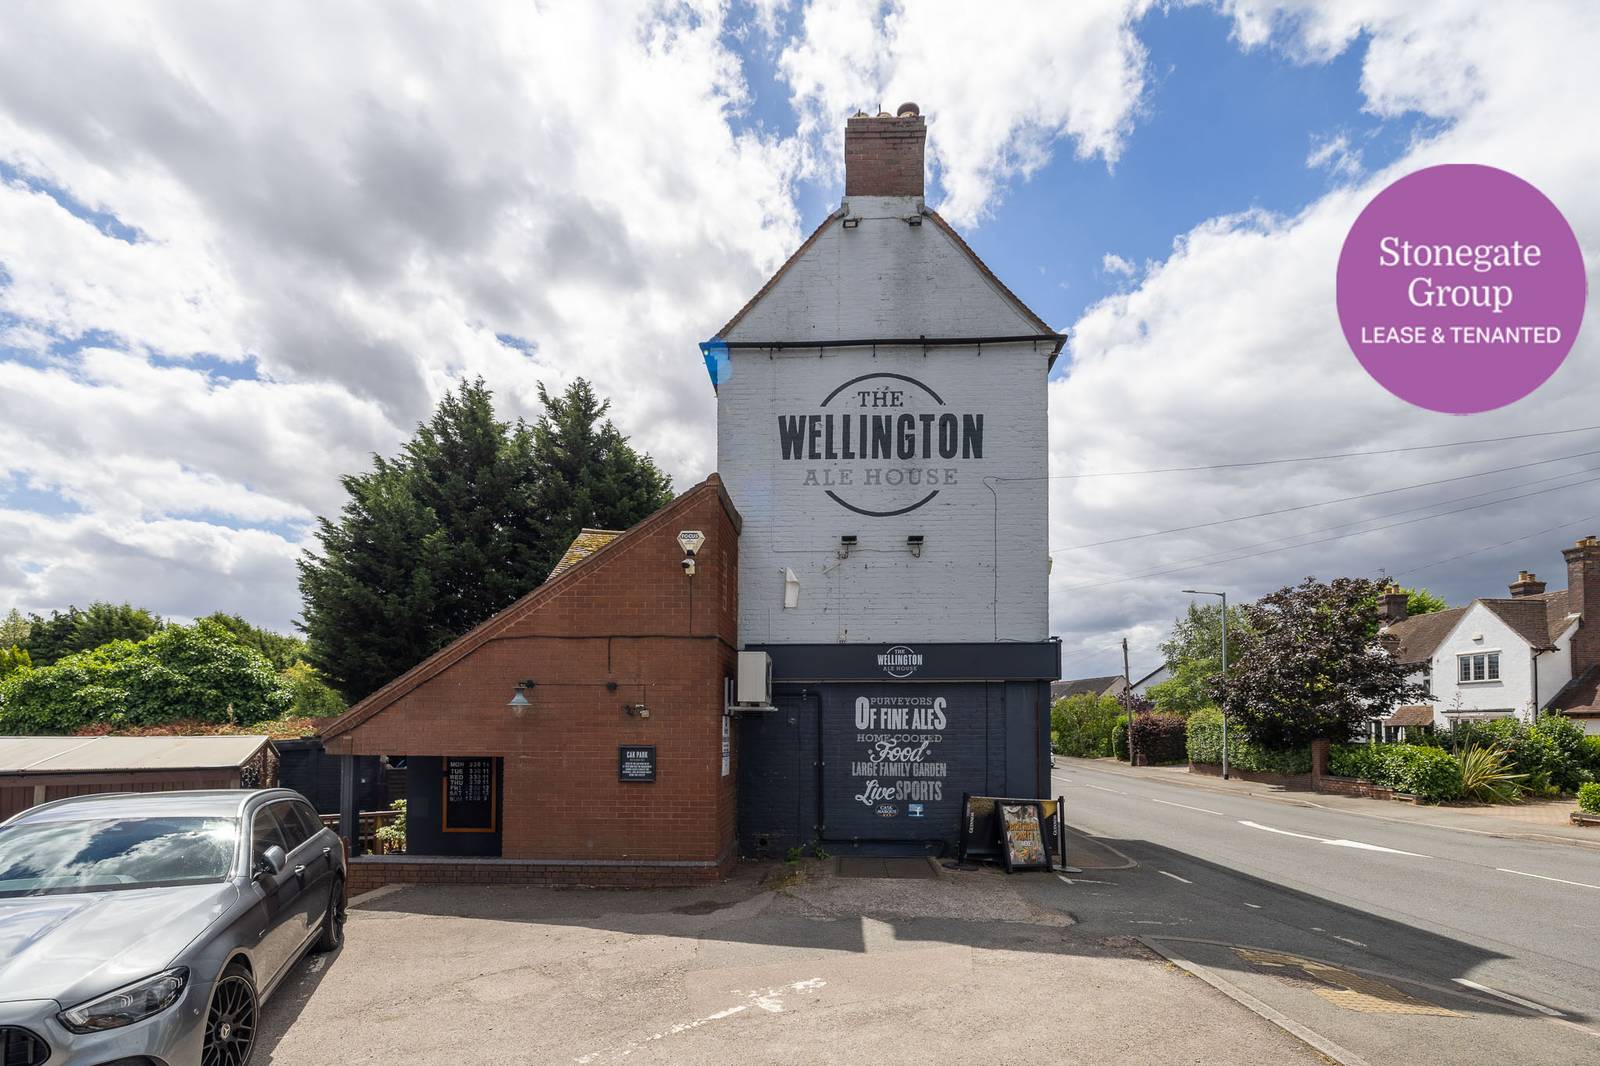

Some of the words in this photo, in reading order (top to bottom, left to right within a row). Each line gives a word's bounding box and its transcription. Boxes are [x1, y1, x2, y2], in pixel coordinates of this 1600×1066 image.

[857, 390, 904, 407] THE
[778, 413, 984, 460] WELLINGTON
[803, 469, 853, 486] ALE
[864, 468, 959, 485] HOUSE
[877, 654, 923, 666] WELLINGTON
[870, 697, 933, 706] PURVEYORS
[855, 696, 877, 730] OF
[880, 708, 909, 730] FINE
[911, 696, 947, 730] ALES
[857, 734, 891, 742] HOME
[894, 734, 943, 743] COOKED
[626, 751, 636, 759] CAR
[636, 751, 649, 759] PARK
[870, 738, 929, 763] Food
[852, 762, 878, 777] LARGE
[880, 762, 911, 777] FAMILY
[912, 762, 947, 777] GARDEN
[855, 779, 896, 806] Live
[896, 780, 942, 801] SPORTS
